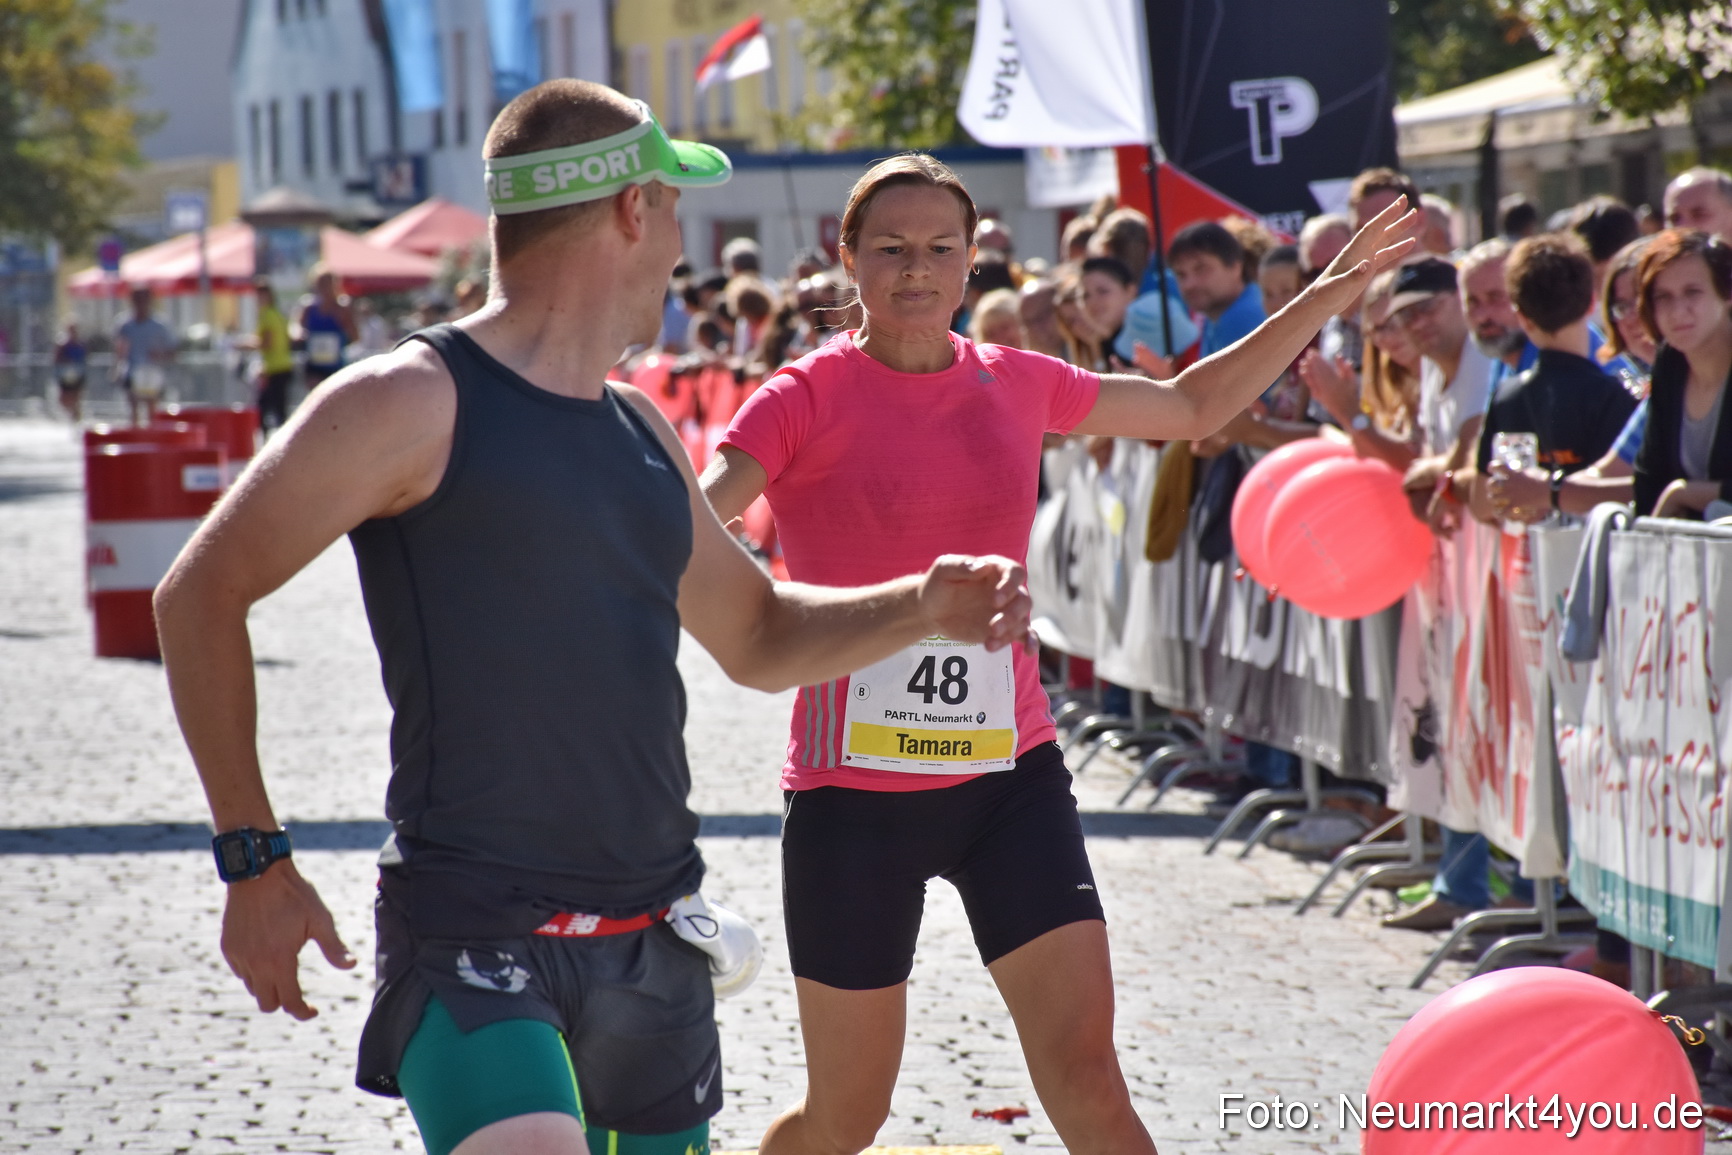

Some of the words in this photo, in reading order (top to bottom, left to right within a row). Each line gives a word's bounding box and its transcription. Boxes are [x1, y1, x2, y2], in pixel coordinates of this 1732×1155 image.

[907, 655, 969, 705] 48
[858, 687, 865, 696] B
[884, 709, 921, 722] PARTL
[924, 713, 973, 723] Neumarkt
[896, 733, 972, 756] Tamara
